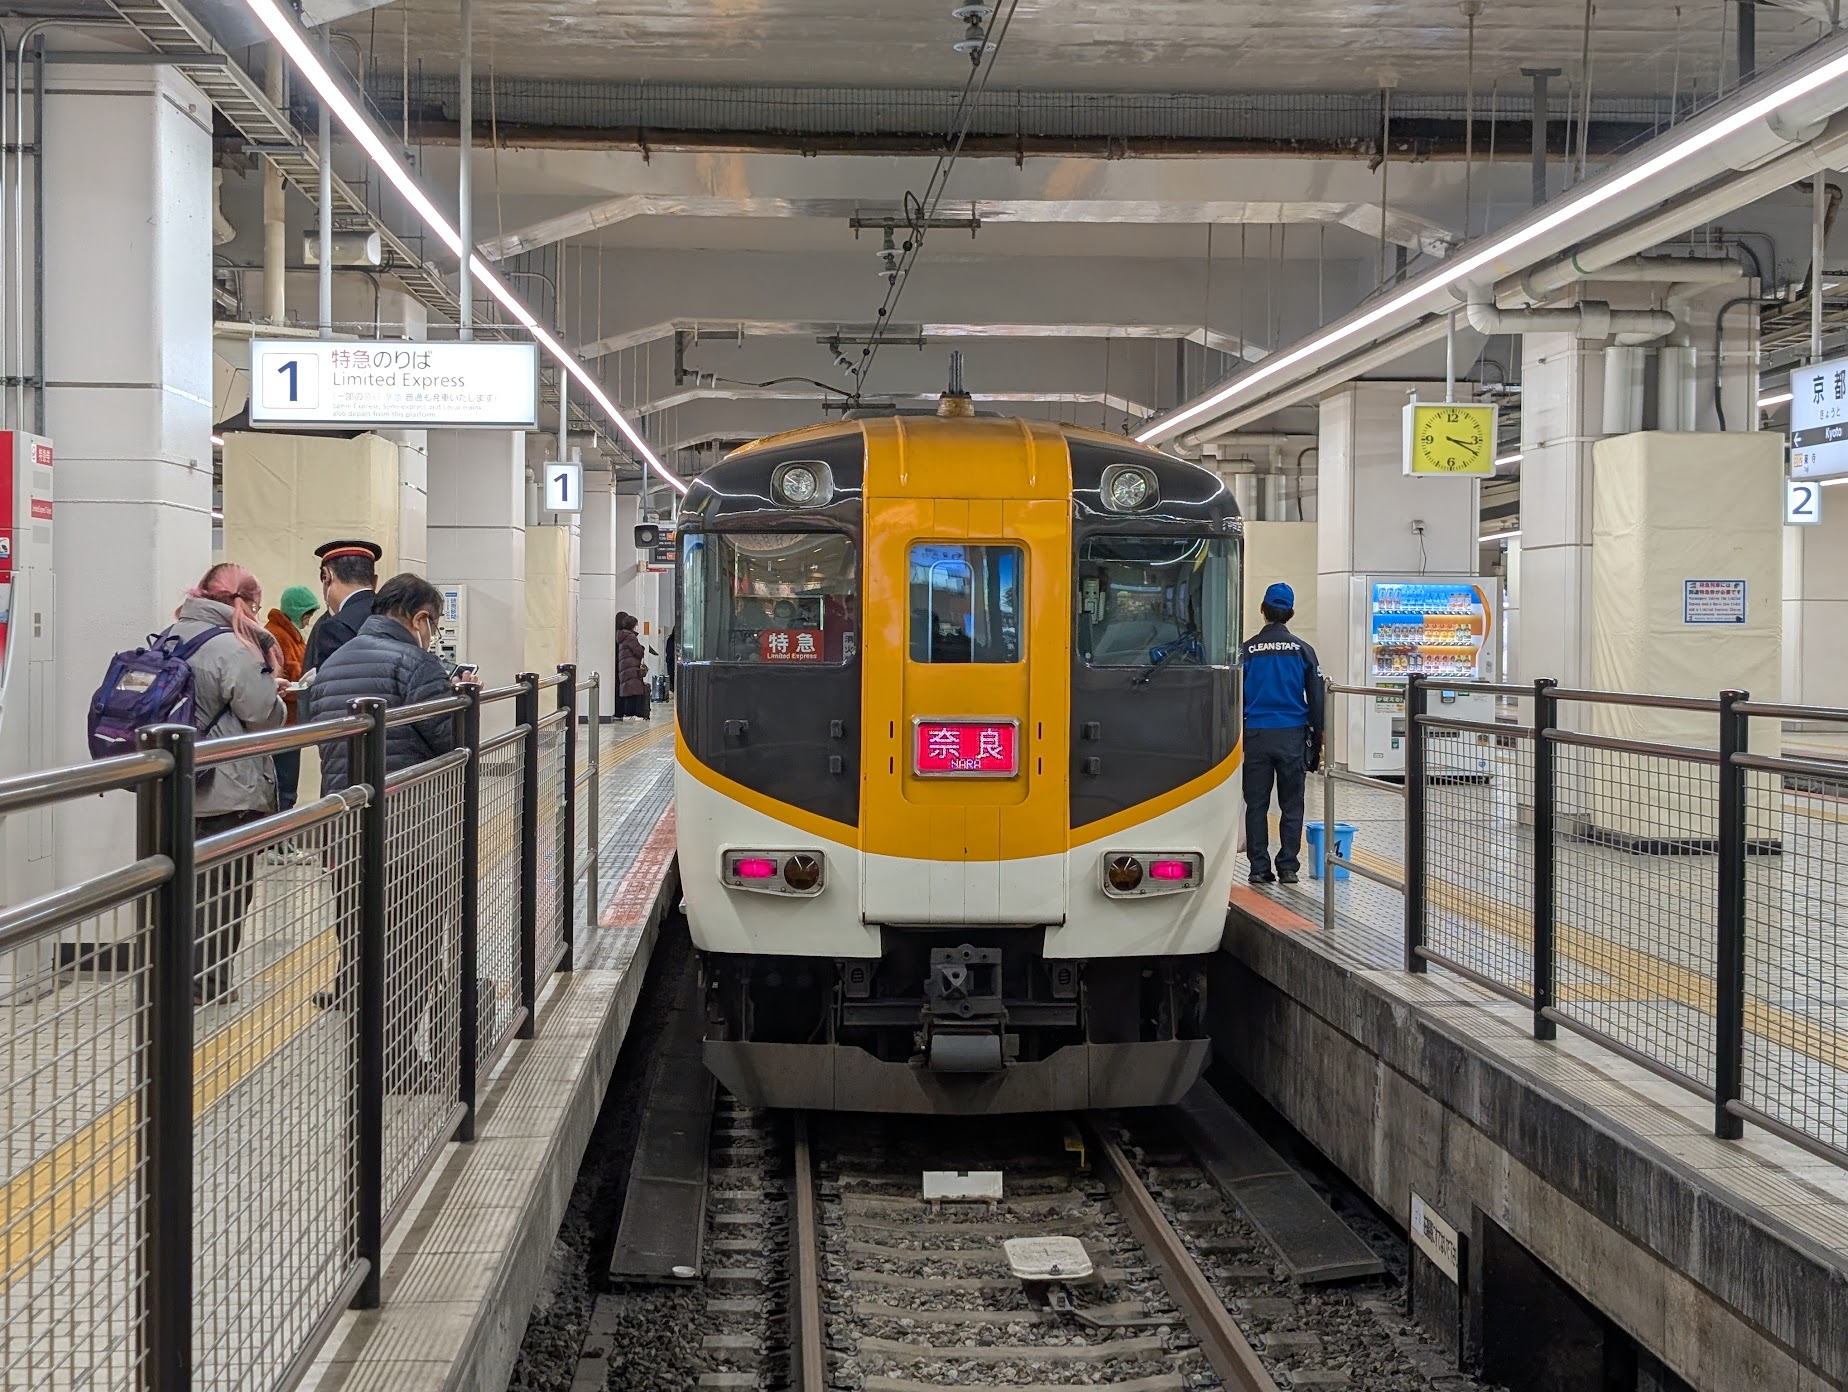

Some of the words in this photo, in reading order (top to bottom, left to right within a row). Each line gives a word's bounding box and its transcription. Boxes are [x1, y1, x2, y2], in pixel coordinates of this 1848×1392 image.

[331, 349, 433, 370] 特急のりば
[277, 360, 298, 402] 1
[333, 371, 396, 386] Limited
[402, 372, 466, 390] Express
[1812, 369, 1847, 405] 京都
[1447, 413, 1459, 423] 12
[1819, 405, 1841, 420] きょうと
[1425, 434, 1435, 445] 9
[1470, 435, 1479, 446] 3
[1825, 426, 1842, 442] Kyoto
[1446, 457, 1456, 467] 6
[553, 473, 568, 502] 1
[1791, 486, 1813, 515] 2
[768, 632, 816, 653] 特急
[1248, 641, 1275, 654] CLEAN
[791, 652, 817, 661] Express
[928, 727, 1004, 760] 奈良
[951, 759, 982, 770] NARA
